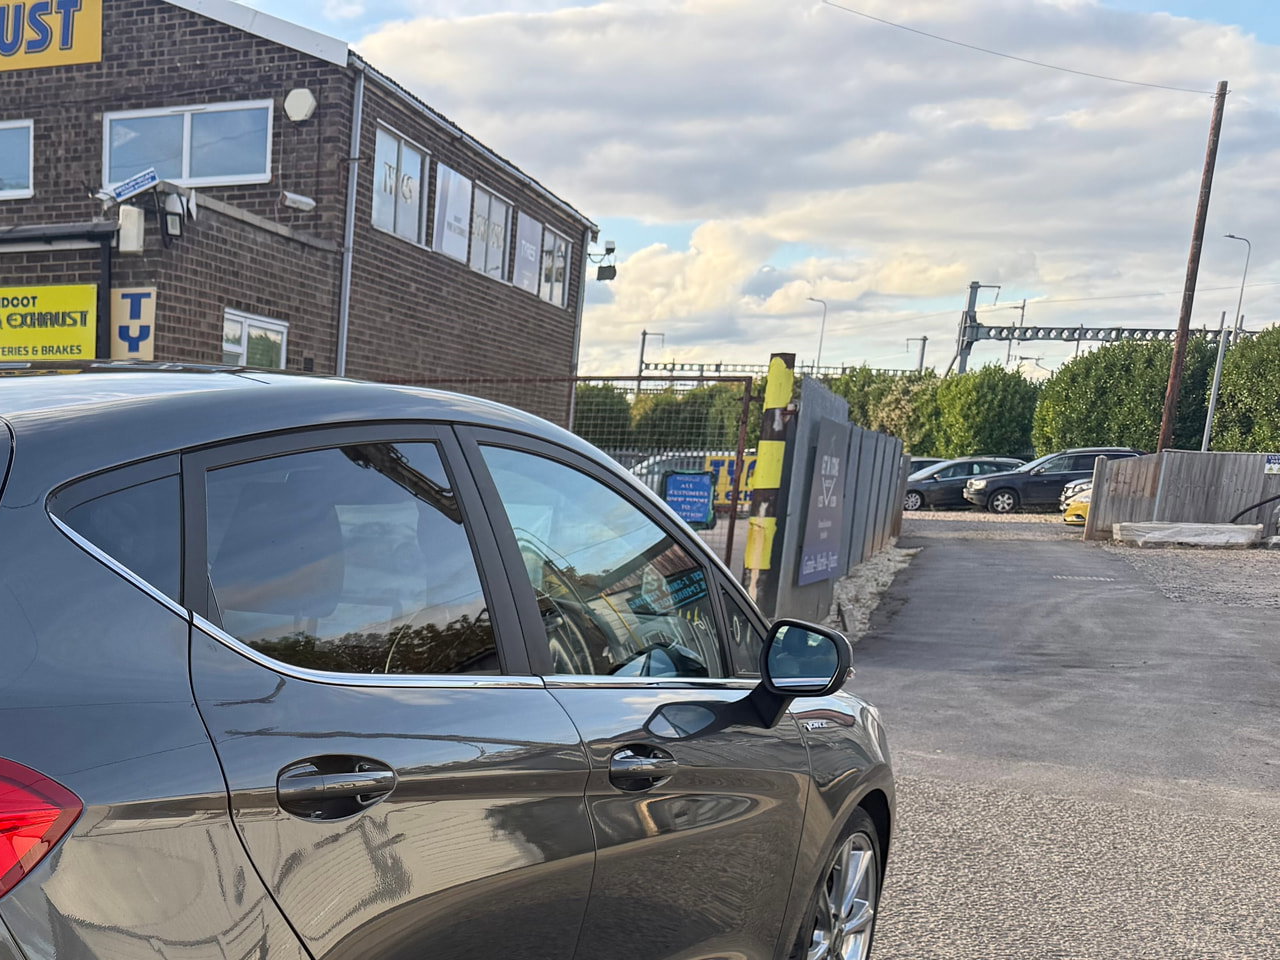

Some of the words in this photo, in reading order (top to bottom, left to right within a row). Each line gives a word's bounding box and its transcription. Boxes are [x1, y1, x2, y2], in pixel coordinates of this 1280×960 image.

[7, 310, 89, 329] EXHAUST
[32, 346, 39, 356] &
[41, 345, 82, 356] BRAKES
